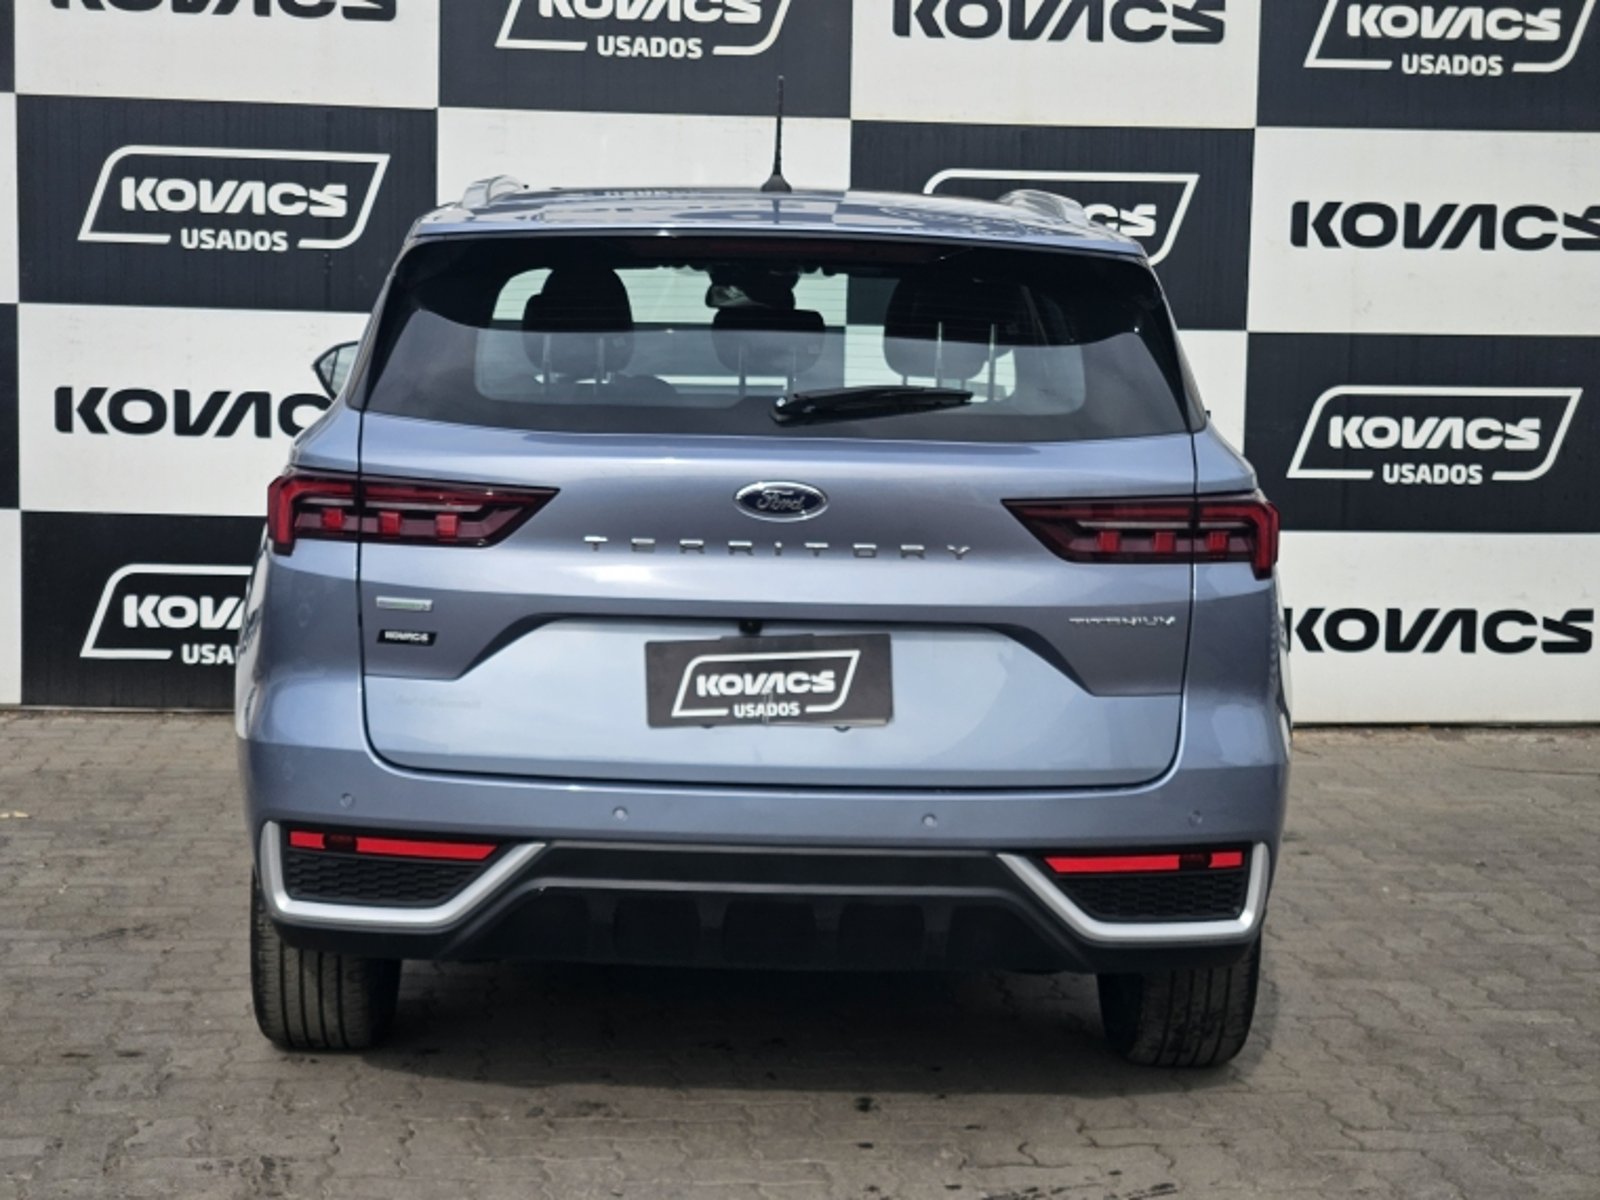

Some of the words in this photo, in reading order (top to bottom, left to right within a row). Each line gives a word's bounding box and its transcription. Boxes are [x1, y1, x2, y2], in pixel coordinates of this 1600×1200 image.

[1346, 3, 1561, 41] KOVACS
[597, 35, 703, 59] USADOS
[1401, 53, 1503, 77] USADOS
[121, 176, 348, 218] KOVACS
[180, 227, 289, 252] USADOS
[54, 386, 333, 439] KOVAC
[1328, 415, 1541, 450] KOVACS
[1382, 463, 1483, 485] USADOS
[756, 489, 806, 510] Ford
[583, 535, 971, 561] TERRITORY
[696, 670, 836, 697] KOVACS
[733, 702, 800, 718] USADOS
